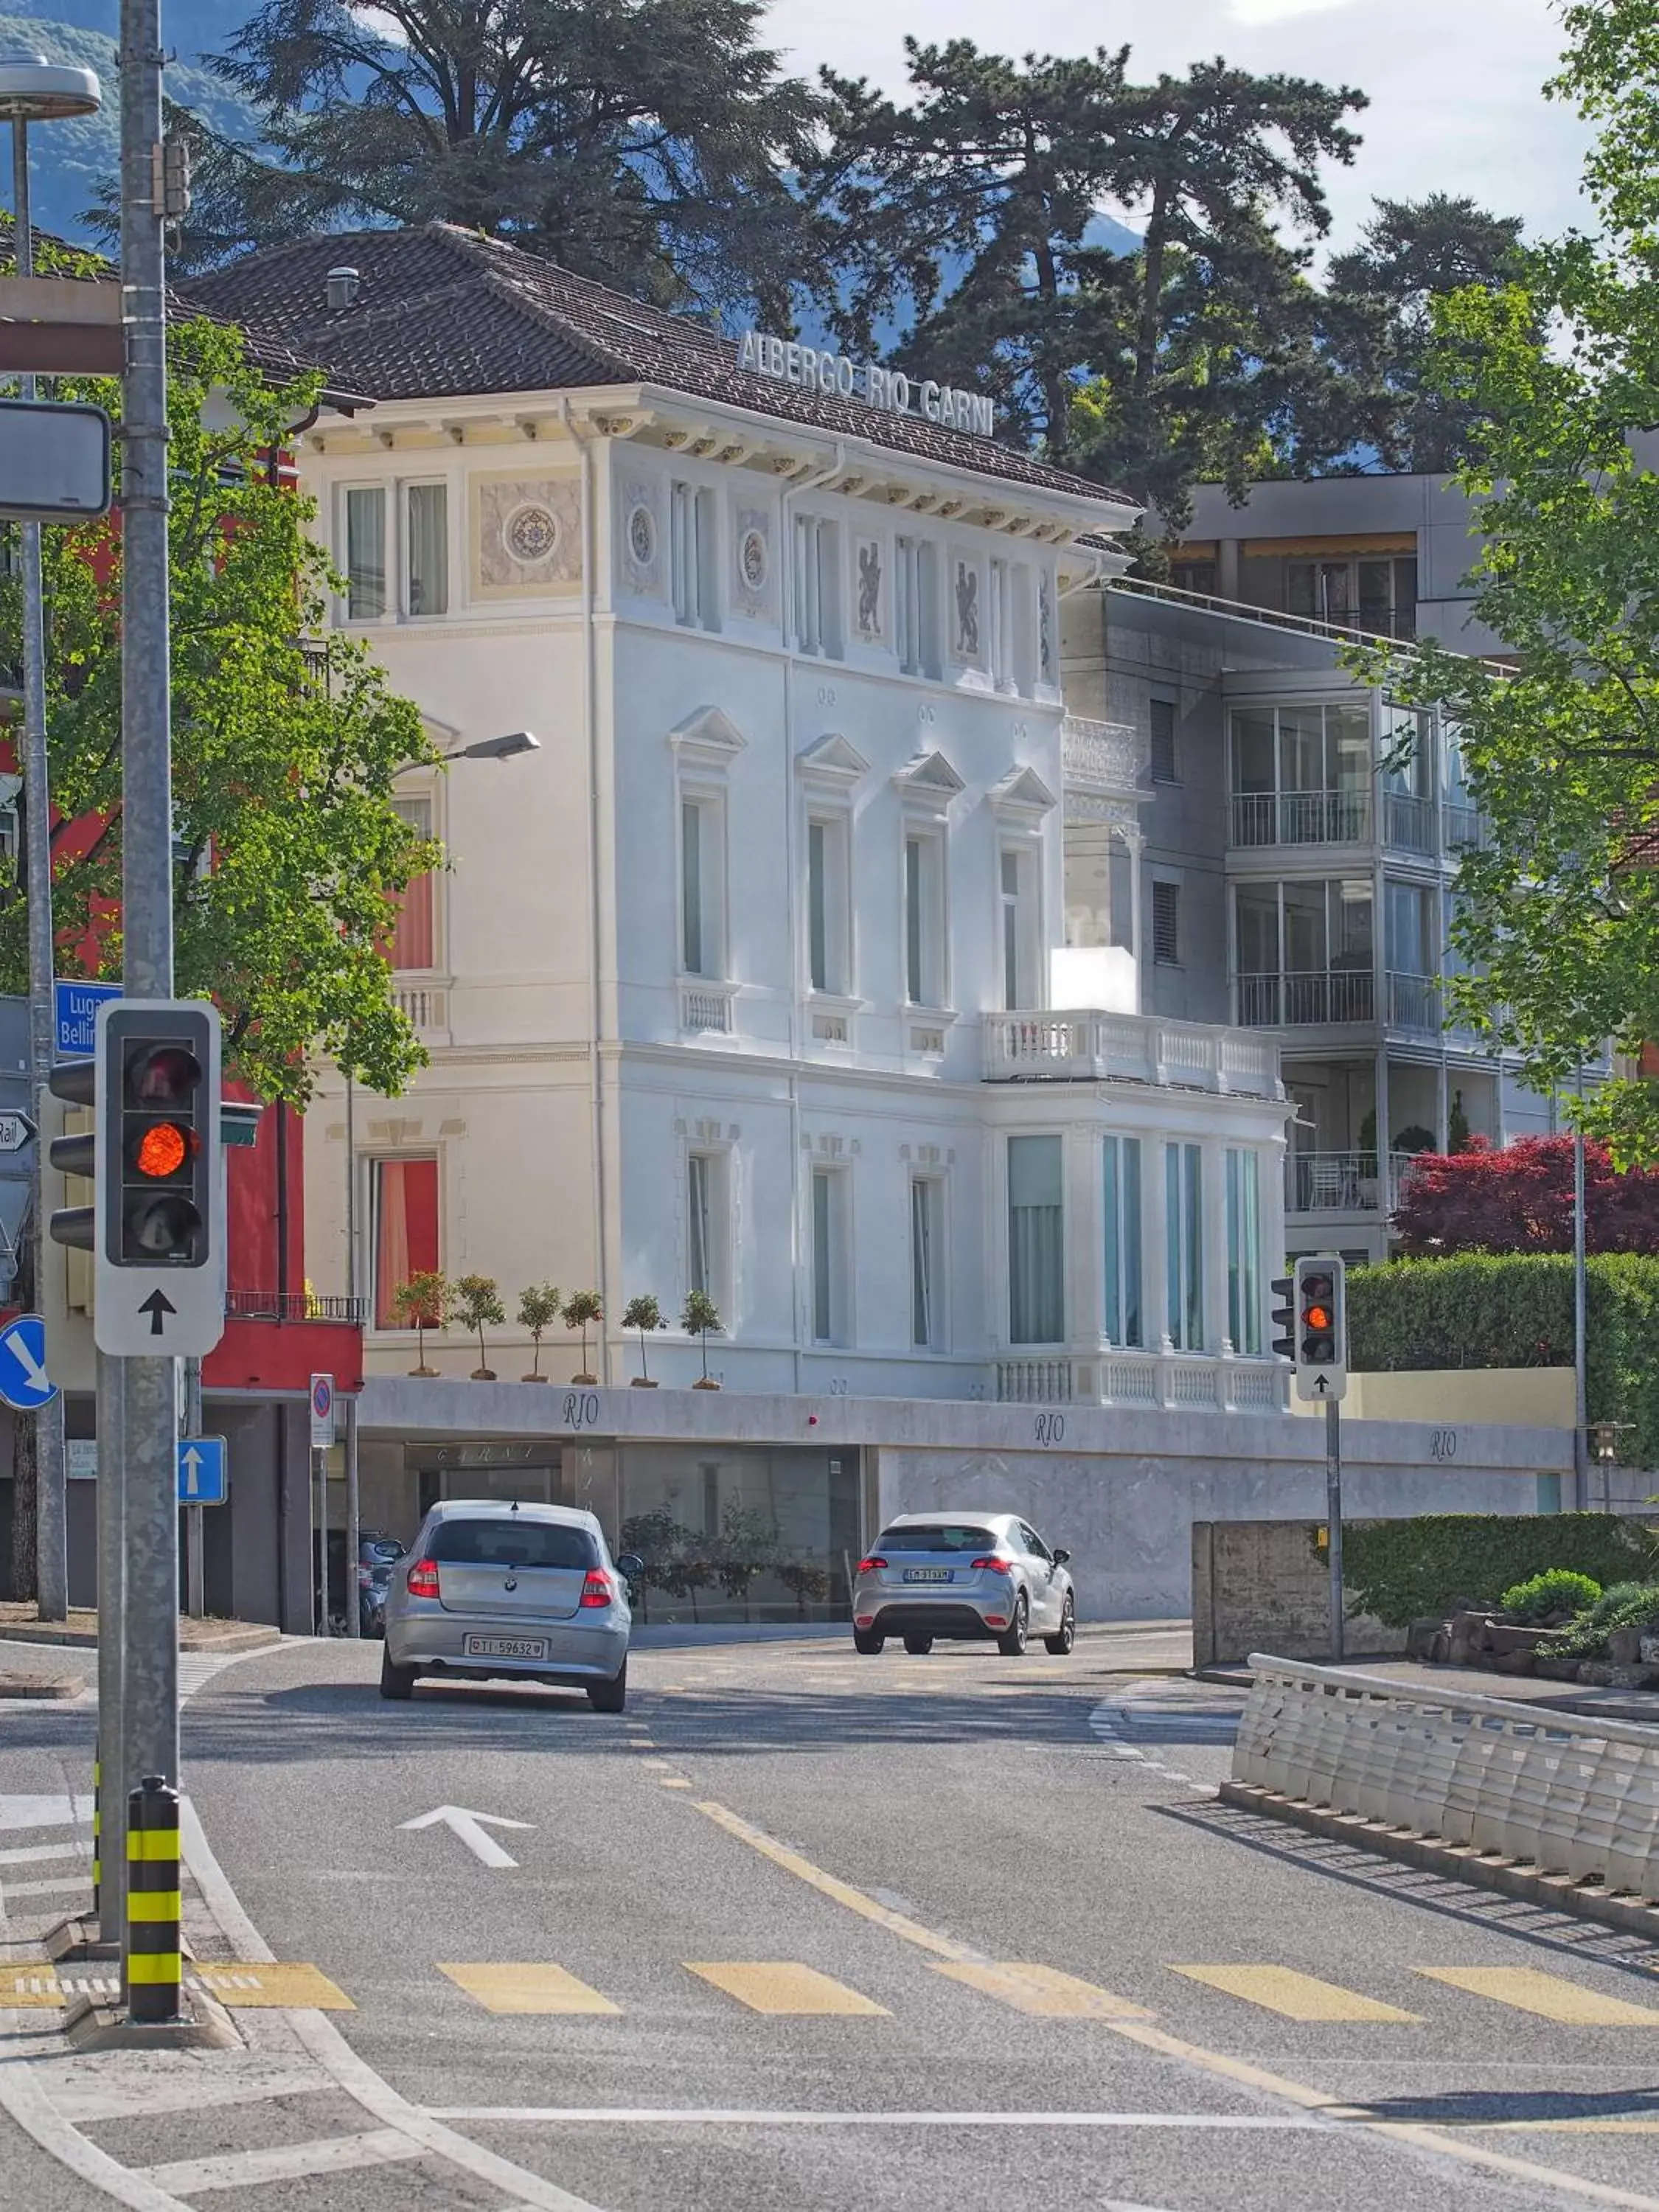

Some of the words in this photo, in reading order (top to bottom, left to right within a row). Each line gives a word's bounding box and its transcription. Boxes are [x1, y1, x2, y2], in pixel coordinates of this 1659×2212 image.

[737, 330, 853, 395] ALBERGO
[866, 365, 909, 414] RIO
[920, 380, 993, 437] GARNI
[563, 1393, 599, 1430] RIO
[1034, 1413, 1064, 1447] RIO
[1430, 1430, 1456, 1462] RIO
